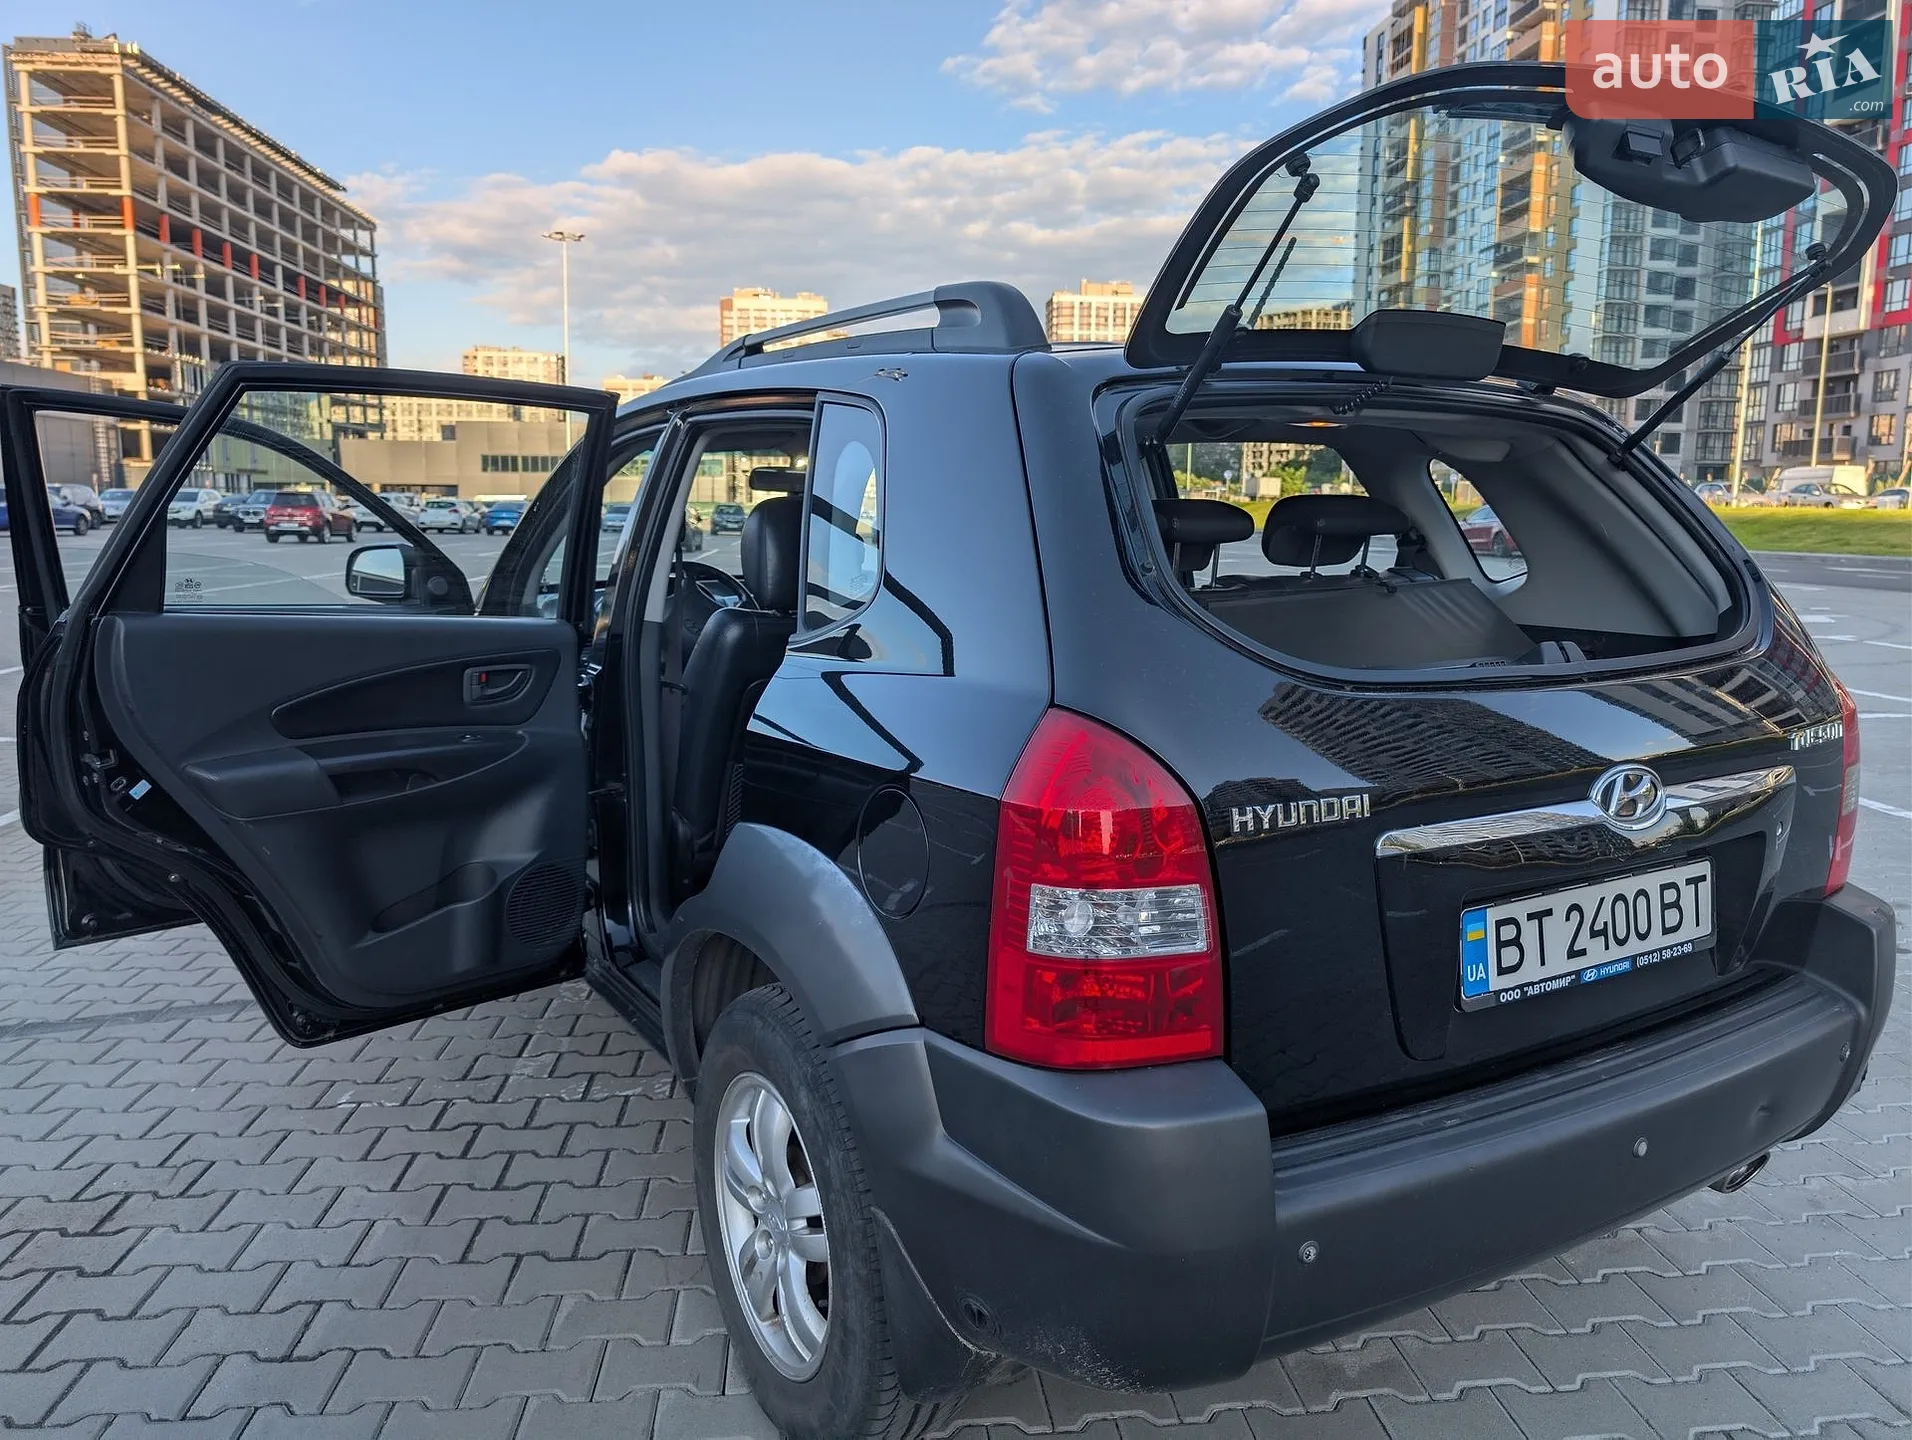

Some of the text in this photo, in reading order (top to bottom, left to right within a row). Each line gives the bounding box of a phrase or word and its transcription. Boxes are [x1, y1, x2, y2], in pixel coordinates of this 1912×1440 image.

[1787, 722, 1843, 751] TUCSON
[1231, 793, 1371, 833] HYUNDAI
[1494, 874, 1708, 977] BT 2400 BT
[1599, 961, 1630, 977] HYUNDAI
[1636, 942, 1693, 969] (0512) 58-23-69
[1467, 964, 1486, 982] UA
[1523, 974, 1576, 997] "АВТОМИР"
